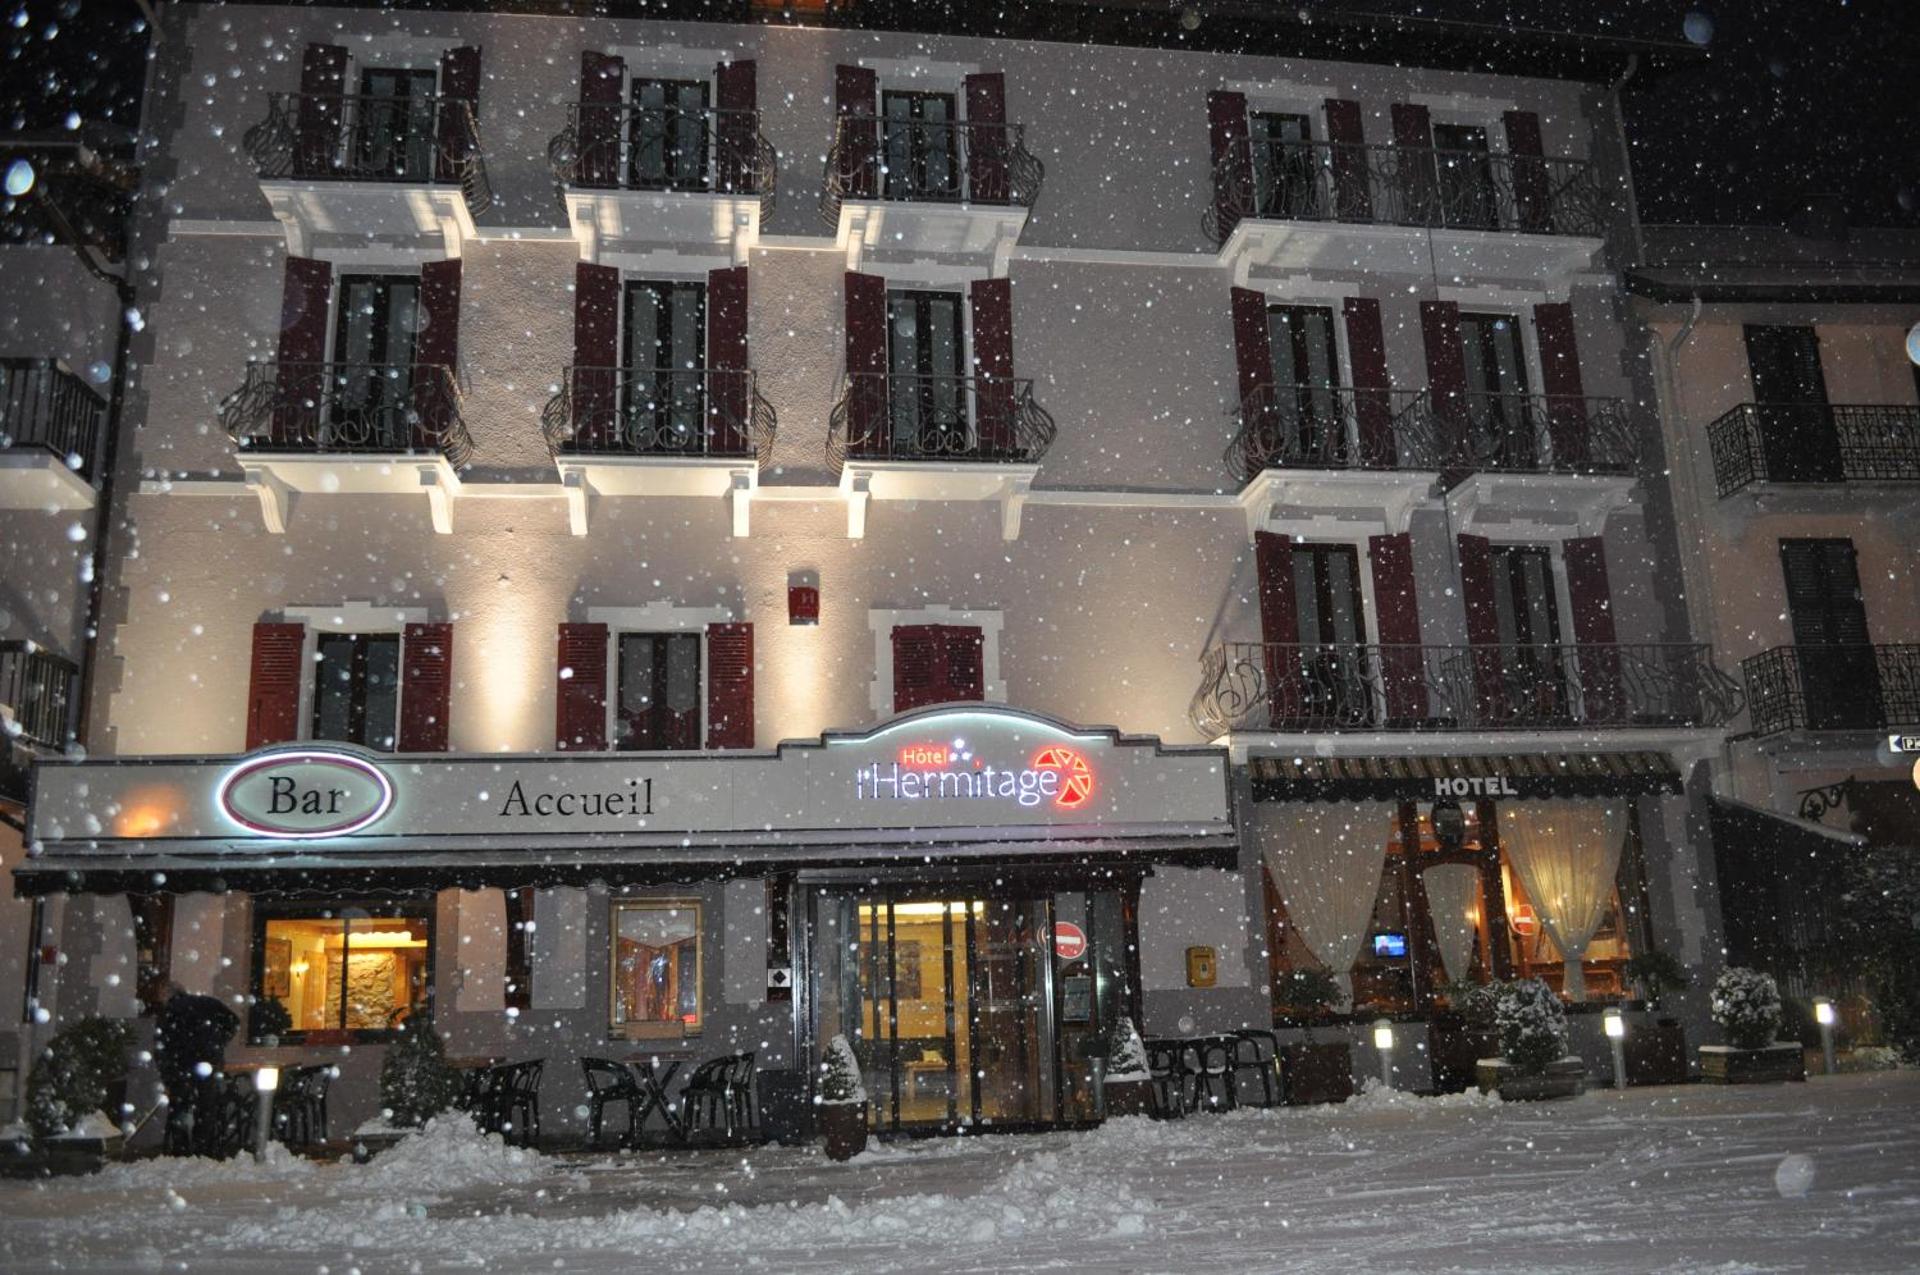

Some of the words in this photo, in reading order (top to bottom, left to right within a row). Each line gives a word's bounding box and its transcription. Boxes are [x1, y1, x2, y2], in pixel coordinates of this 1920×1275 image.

[266, 776, 345, 815] Bar
[499, 778, 655, 817] Accueil
[1434, 777, 1519, 796] HOTEL
